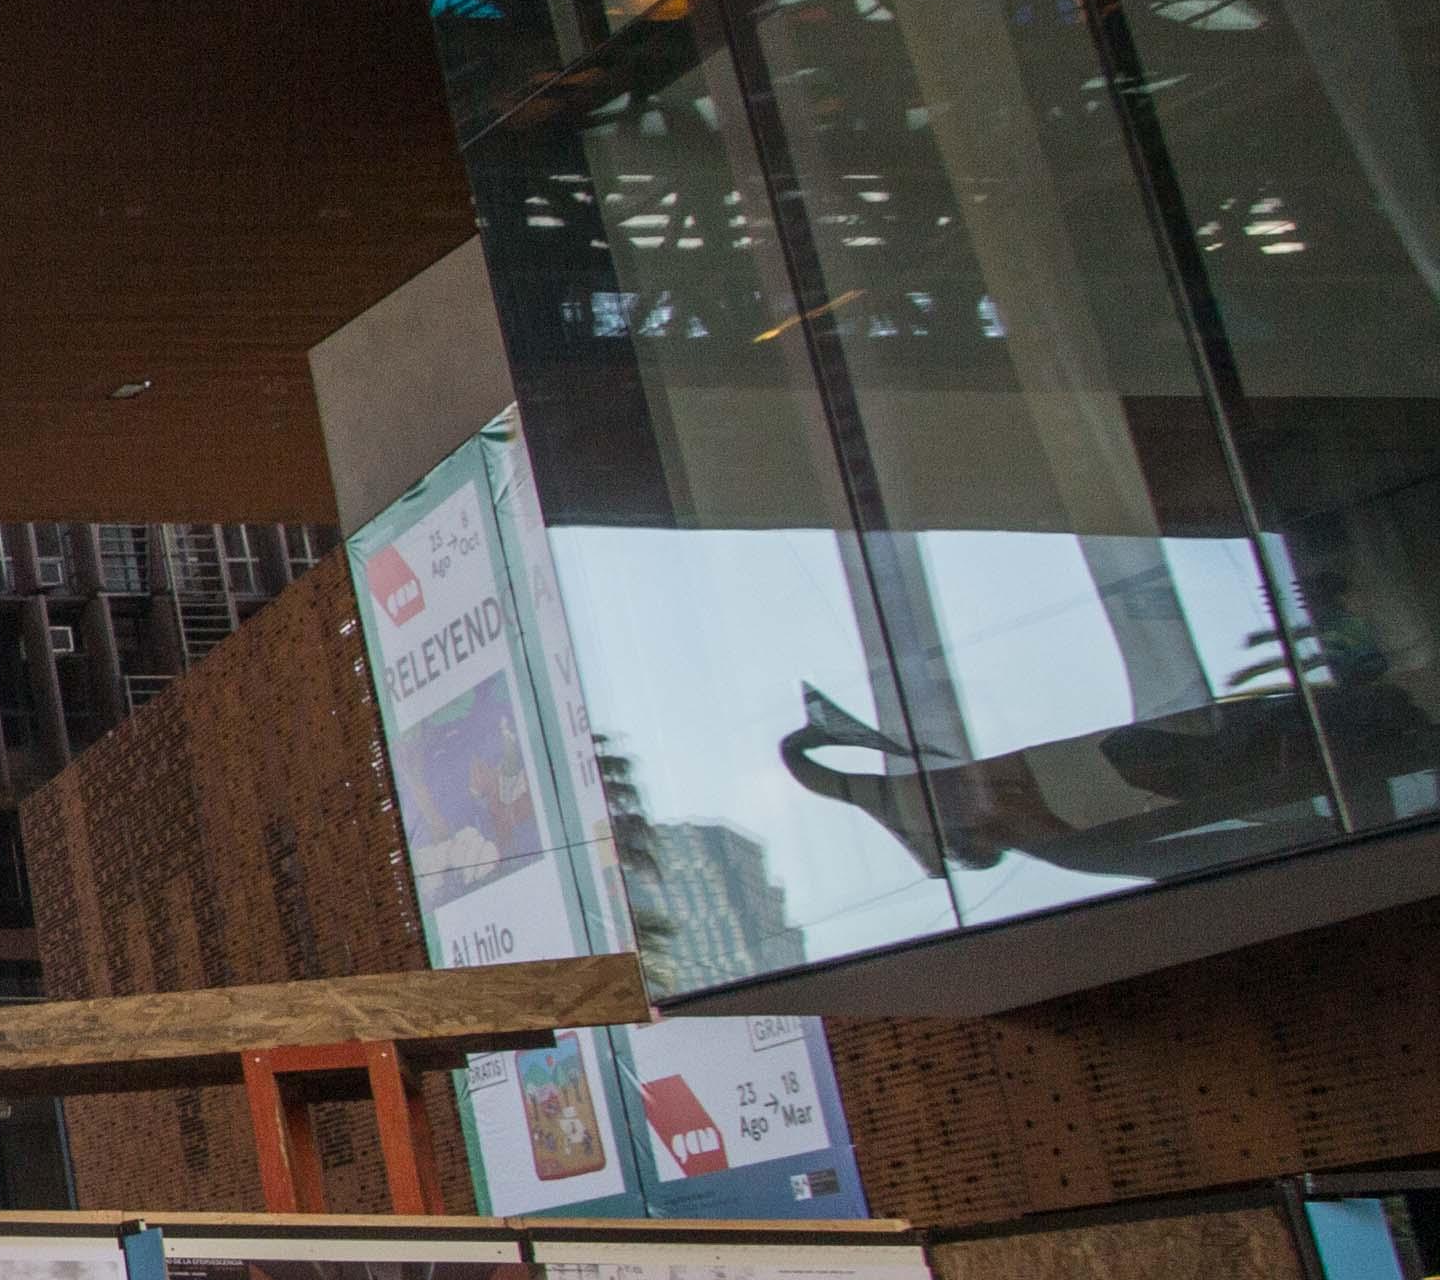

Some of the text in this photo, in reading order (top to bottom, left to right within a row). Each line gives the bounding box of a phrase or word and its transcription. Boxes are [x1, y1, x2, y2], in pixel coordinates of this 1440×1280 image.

[477, 922, 514, 959] hilo
[736, 1070, 800, 1108] 23 18
[740, 1102, 813, 1142] Ago Mar
